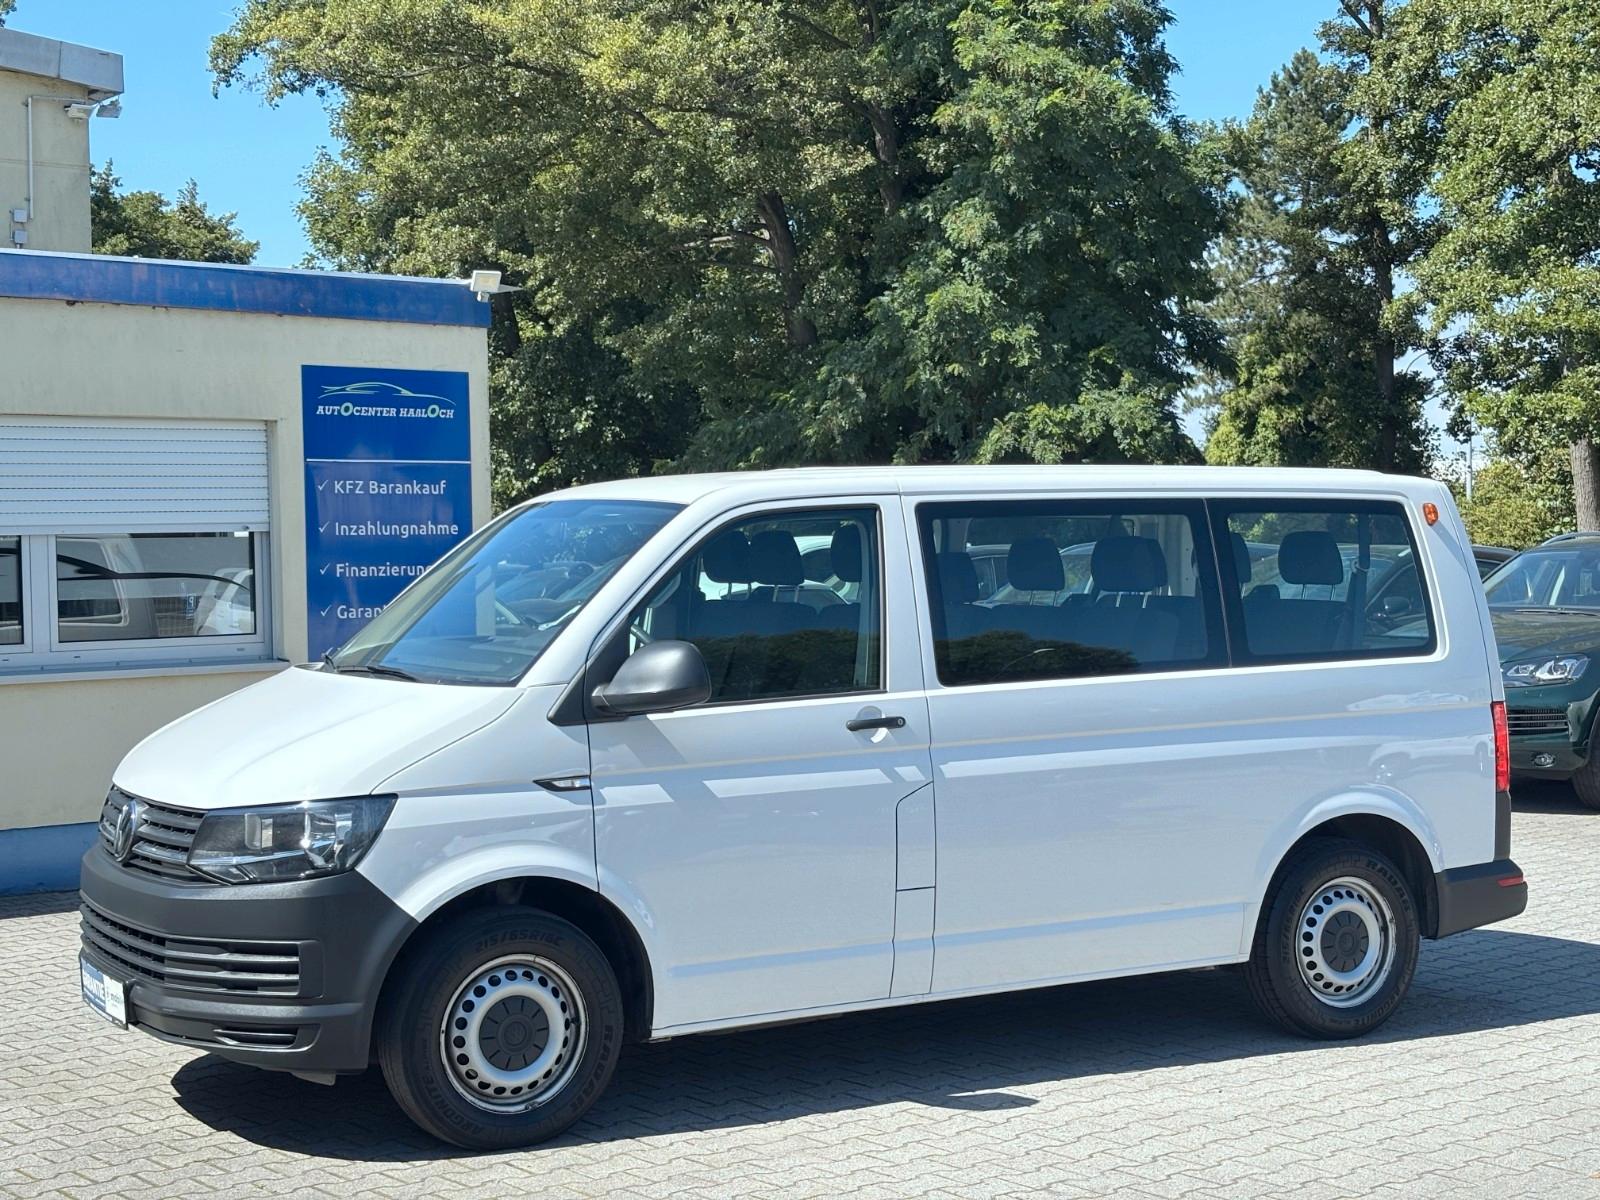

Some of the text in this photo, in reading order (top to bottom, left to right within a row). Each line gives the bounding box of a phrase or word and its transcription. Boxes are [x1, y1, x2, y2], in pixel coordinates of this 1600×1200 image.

[316, 402, 397, 417] AUTOCENTER
[334, 479, 447, 495] KFZ Barankauf
[335, 521, 459, 538] Inzahlungnahme
[336, 562, 432, 577] Finanzierun
[337, 605, 386, 619] Garan
[1366, 858, 1410, 912] RADAR
